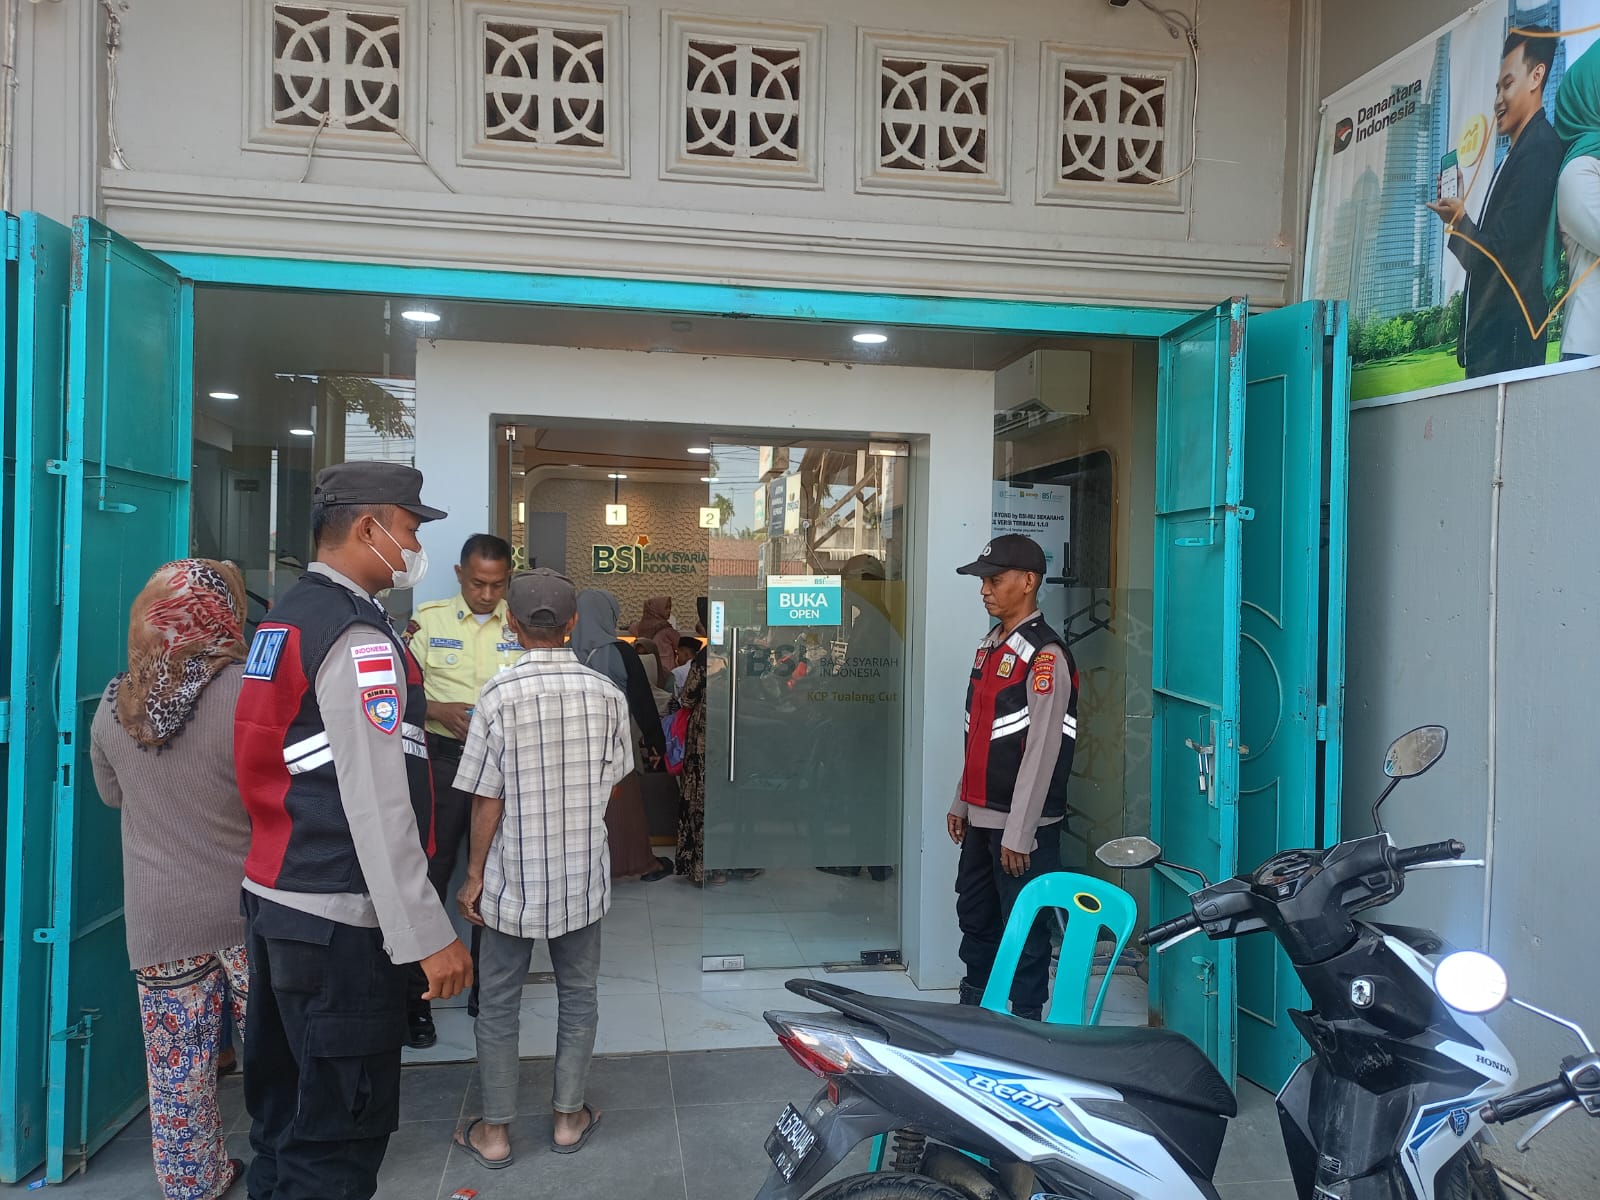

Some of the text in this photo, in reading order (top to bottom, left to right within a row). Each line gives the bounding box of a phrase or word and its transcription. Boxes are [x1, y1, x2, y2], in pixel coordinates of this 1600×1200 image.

[1357, 79, 1422, 125] Danantara
[1356, 101, 1416, 143] Indonesia
[612, 509, 619, 521] 1
[705, 512, 714, 525] 2
[593, 543, 643, 574] BSI
[643, 552, 708, 564] BANK SYARIA
[643, 564, 697, 574] INDONESIA
[779, 592, 829, 608] BUKA
[789, 609, 820, 619] OPEN
[354, 645, 389, 655] INDONESIA
[852, 657, 898, 668] SYARIAH
[819, 667, 881, 678] INDONESIA
[807, 691, 897, 704] KCP Tualang Cut
[1475, 1054, 1512, 1076] HONDA
